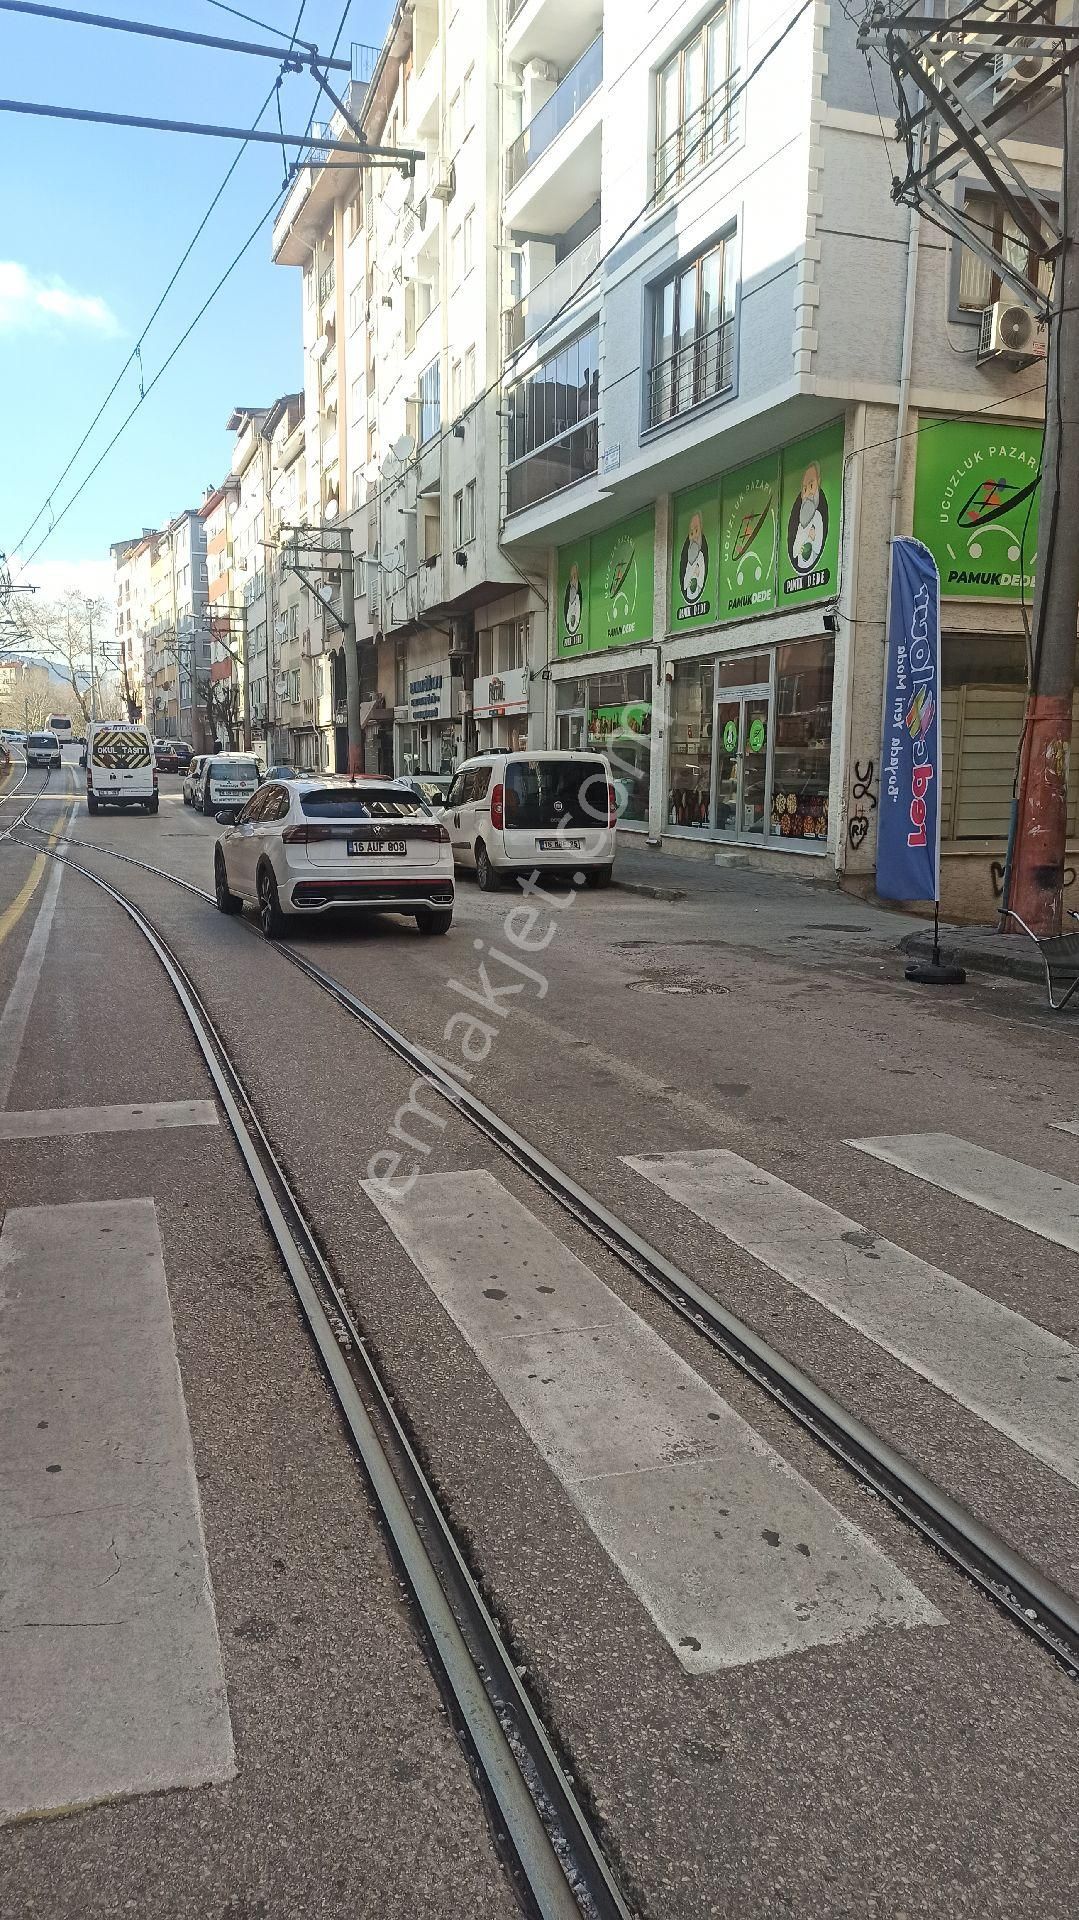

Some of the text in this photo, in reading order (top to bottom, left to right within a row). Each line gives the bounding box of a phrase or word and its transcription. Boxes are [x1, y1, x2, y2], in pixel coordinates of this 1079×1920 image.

[940, 452, 984, 523] UCUZLUK
[97, 746, 118, 754] OKUL
[353, 842, 364, 852] 16
[367, 842, 385, 852] AUF
